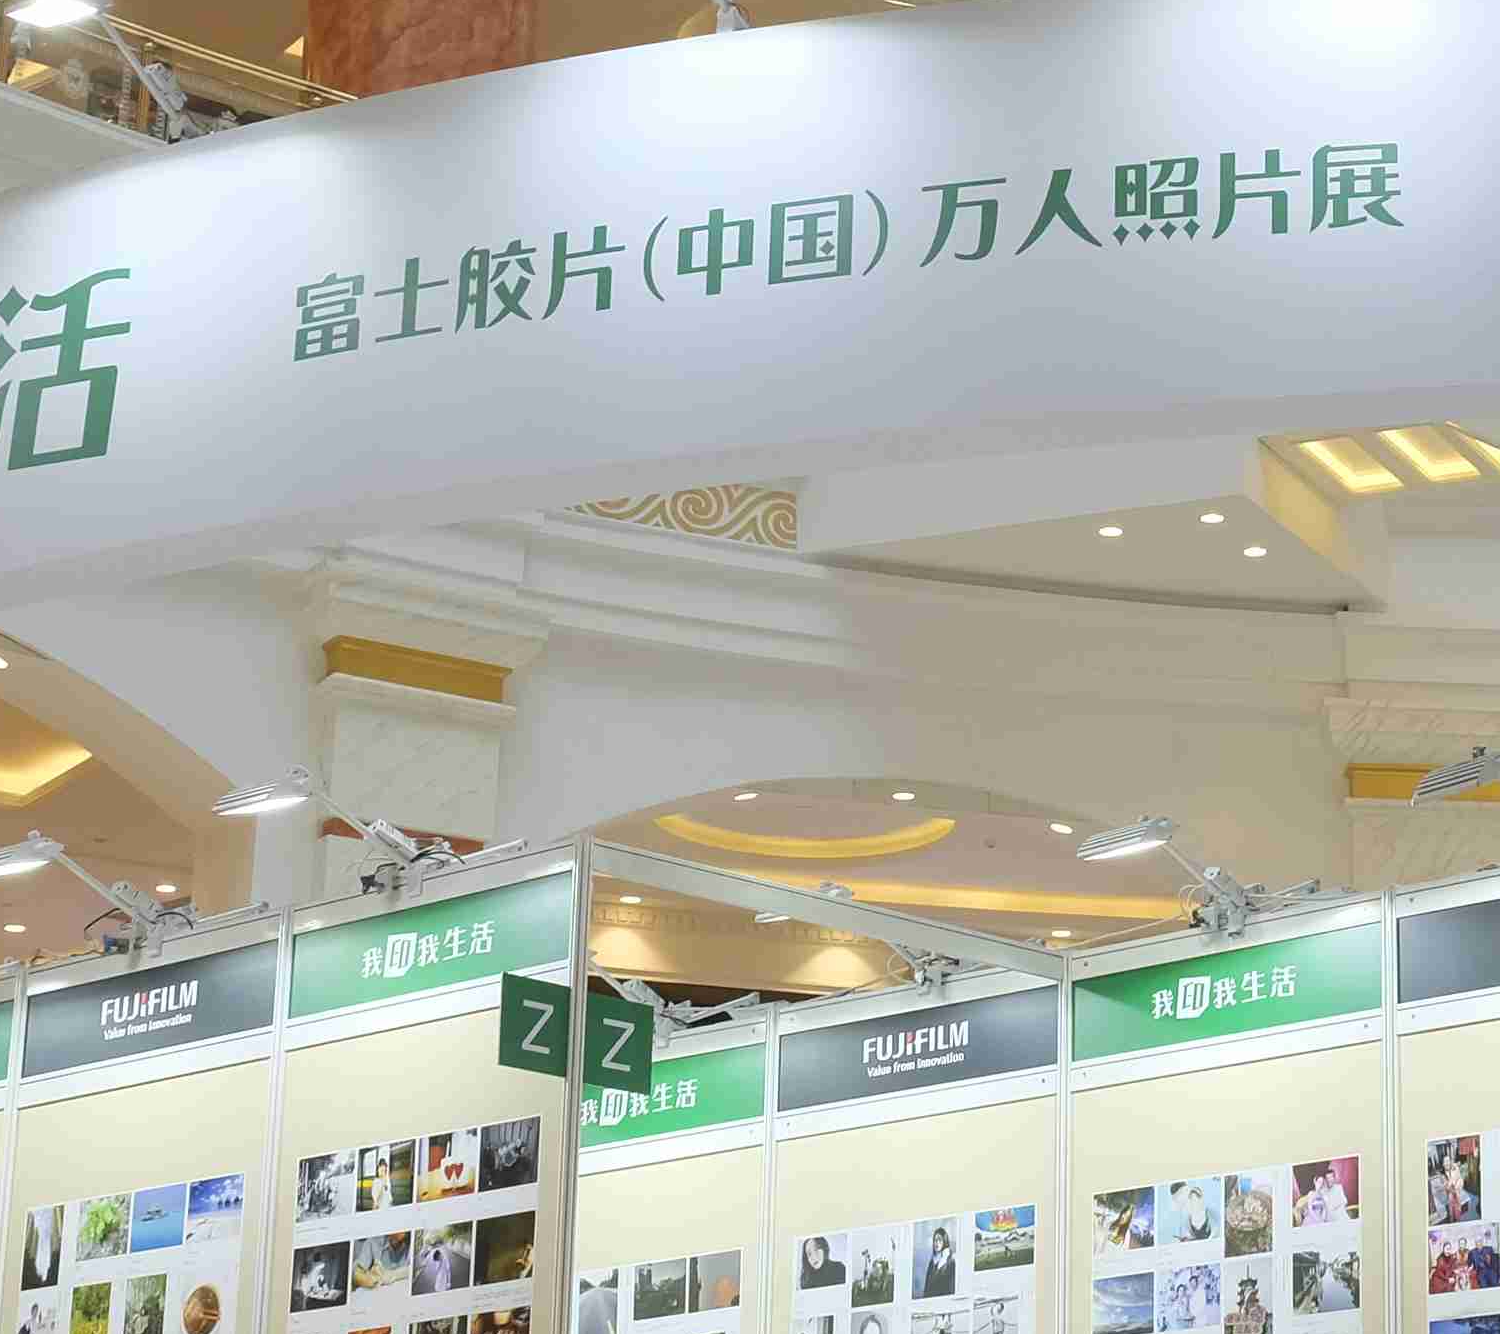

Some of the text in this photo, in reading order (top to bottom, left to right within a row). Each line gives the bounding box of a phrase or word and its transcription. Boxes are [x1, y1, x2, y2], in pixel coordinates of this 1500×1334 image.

[361, 920, 497, 979] 我印我生活
[100, 979, 199, 1025] FUJIFILM
[1151, 964, 1298, 1020] 我印我生活
[521, 999, 554, 1055] Z
[601, 1018, 635, 1072] Z
[862, 1020, 969, 1063] FUJIFILM
